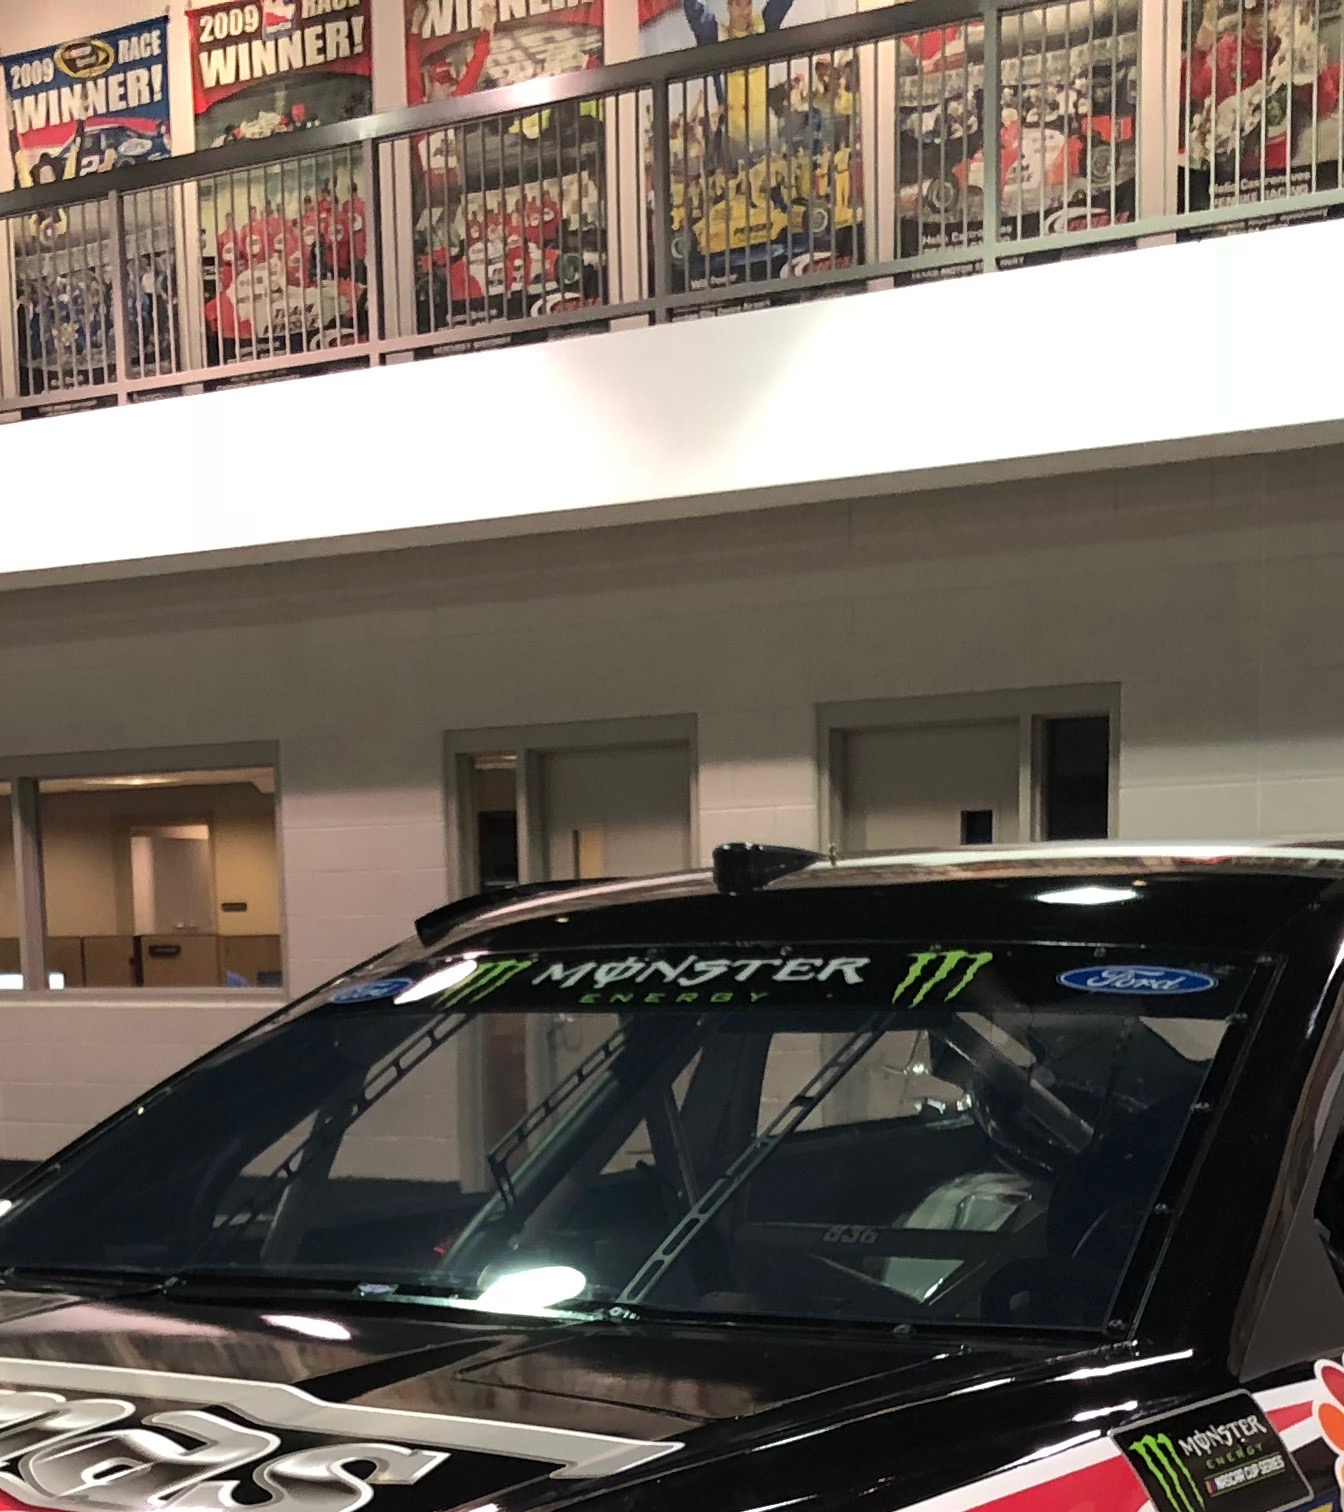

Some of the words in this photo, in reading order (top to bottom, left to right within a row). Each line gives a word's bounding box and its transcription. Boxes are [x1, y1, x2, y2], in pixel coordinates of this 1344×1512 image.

[199, 7, 259, 43] 2009
[9, 57, 55, 90] 2009
[117, 30, 162, 64] RACE
[199, 16, 366, 89] WINNER!
[13, 64, 163, 134] WINNER!
[579, 992, 768, 1004] ENERGY
[1086, 968, 1185, 992] Ford
